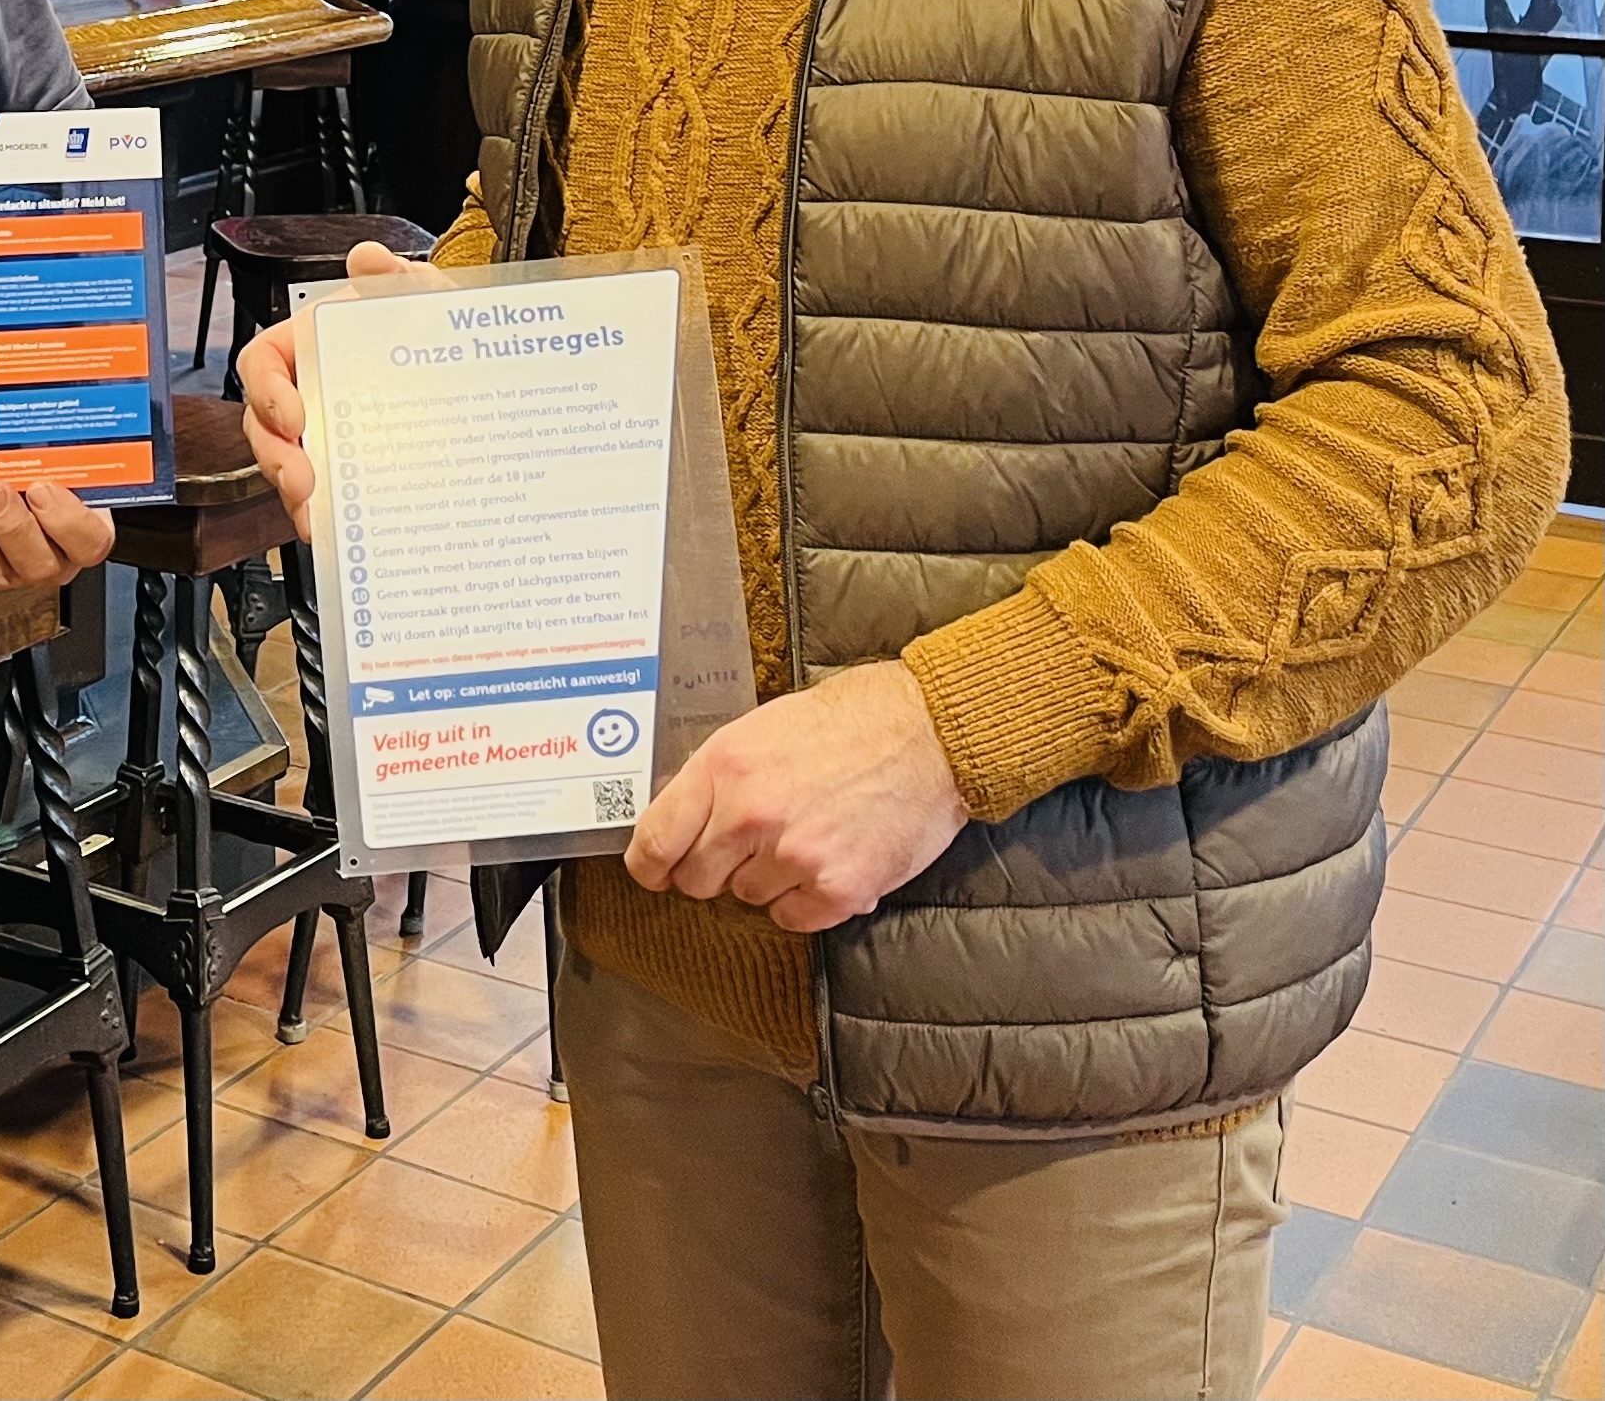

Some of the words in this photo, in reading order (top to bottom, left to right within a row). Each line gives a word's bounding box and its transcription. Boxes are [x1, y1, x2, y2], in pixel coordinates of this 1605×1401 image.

[109, 135, 148, 150] PVO
[37, 197, 80, 210] situatie?
[80, 196, 105, 209] Meld
[106, 195, 126, 208] het!
[448, 304, 565, 330] Welkom
[389, 345, 464, 367] Onze
[472, 326, 624, 360] huisregels
[472, 391, 495, 402] van
[497, 388, 516, 399] het
[519, 382, 579, 399] personeel
[582, 382, 598, 394] op
[472, 411, 495, 423] met
[498, 405, 563, 422] legitimatie
[566, 399, 619, 414] mogelijk
[449, 432, 485, 445] onder
[489, 428, 533, 441] invloed
[536, 427, 559, 437] van
[562, 421, 606, 435] alcohol
[609, 420, 622, 430] of
[625, 417, 660, 430] drugs
[455, 455, 485, 468] geen
[619, 438, 664, 450] kleding
[366, 483, 398, 495] Geen
[401, 479, 445, 492] alcohol
[448, 474, 485, 487] onder
[487, 472, 503, 483] de
[506, 470, 520, 482] 18
[522, 469, 547, 483] jaar
[369, 505, 412, 516] Binnen
[414, 499, 450, 512] wordt
[453, 496, 477, 507] niet
[480, 492, 527, 508] gerookt
[371, 525, 402, 536] Geen
[456, 516, 502, 529] racisme
[503, 514, 515, 524] of
[517, 508, 589, 524] ongewenste
[591, 502, 661, 516] intimiteiten
[373, 547, 404, 558] Geen
[407, 544, 442, 557] eigen
[444, 539, 479, 551] drank
[482, 537, 495, 547] of
[497, 532, 552, 548] glaswerk
[374, 565, 431, 579] Glaswerk
[433, 561, 465, 573] moet
[468, 559, 511, 570] binnen
[514, 555, 526, 566] of
[529, 555, 546, 566] op
[549, 551, 584, 563] terras
[586, 547, 628, 560] blijven
[377, 589, 409, 600] Geen
[464, 579, 500, 593] drugs
[503, 577, 515, 588] of
[518, 569, 621, 586] lachgaspatronen
[378, 606, 448, 620] Veroorzaak
[450, 603, 481, 616] geen
[483, 599, 532, 612] overlast
[535, 596, 563, 607] voor
[566, 593, 582, 604] de
[584, 591, 622, 602] buren
[381, 631, 402, 643] Wij
[404, 629, 436, 641] doen
[438, 624, 470, 638] altijd
[473, 620, 523, 634] aangifte
[526, 618, 542, 630] bij
[545, 617, 568, 627] een
[570, 612, 625, 624] strafbaar
[628, 609, 649, 620] feit
[409, 688, 431, 702] Let
[433, 688, 457, 701] op:
[460, 675, 567, 697] cameratoezicht
[570, 668, 641, 686] aanwezig!
[373, 729, 431, 752] Veilig
[437, 724, 465, 744] uit
[472, 722, 491, 739] in
[376, 750, 480, 782] gemeente
[485, 735, 578, 763] Moerdijk
